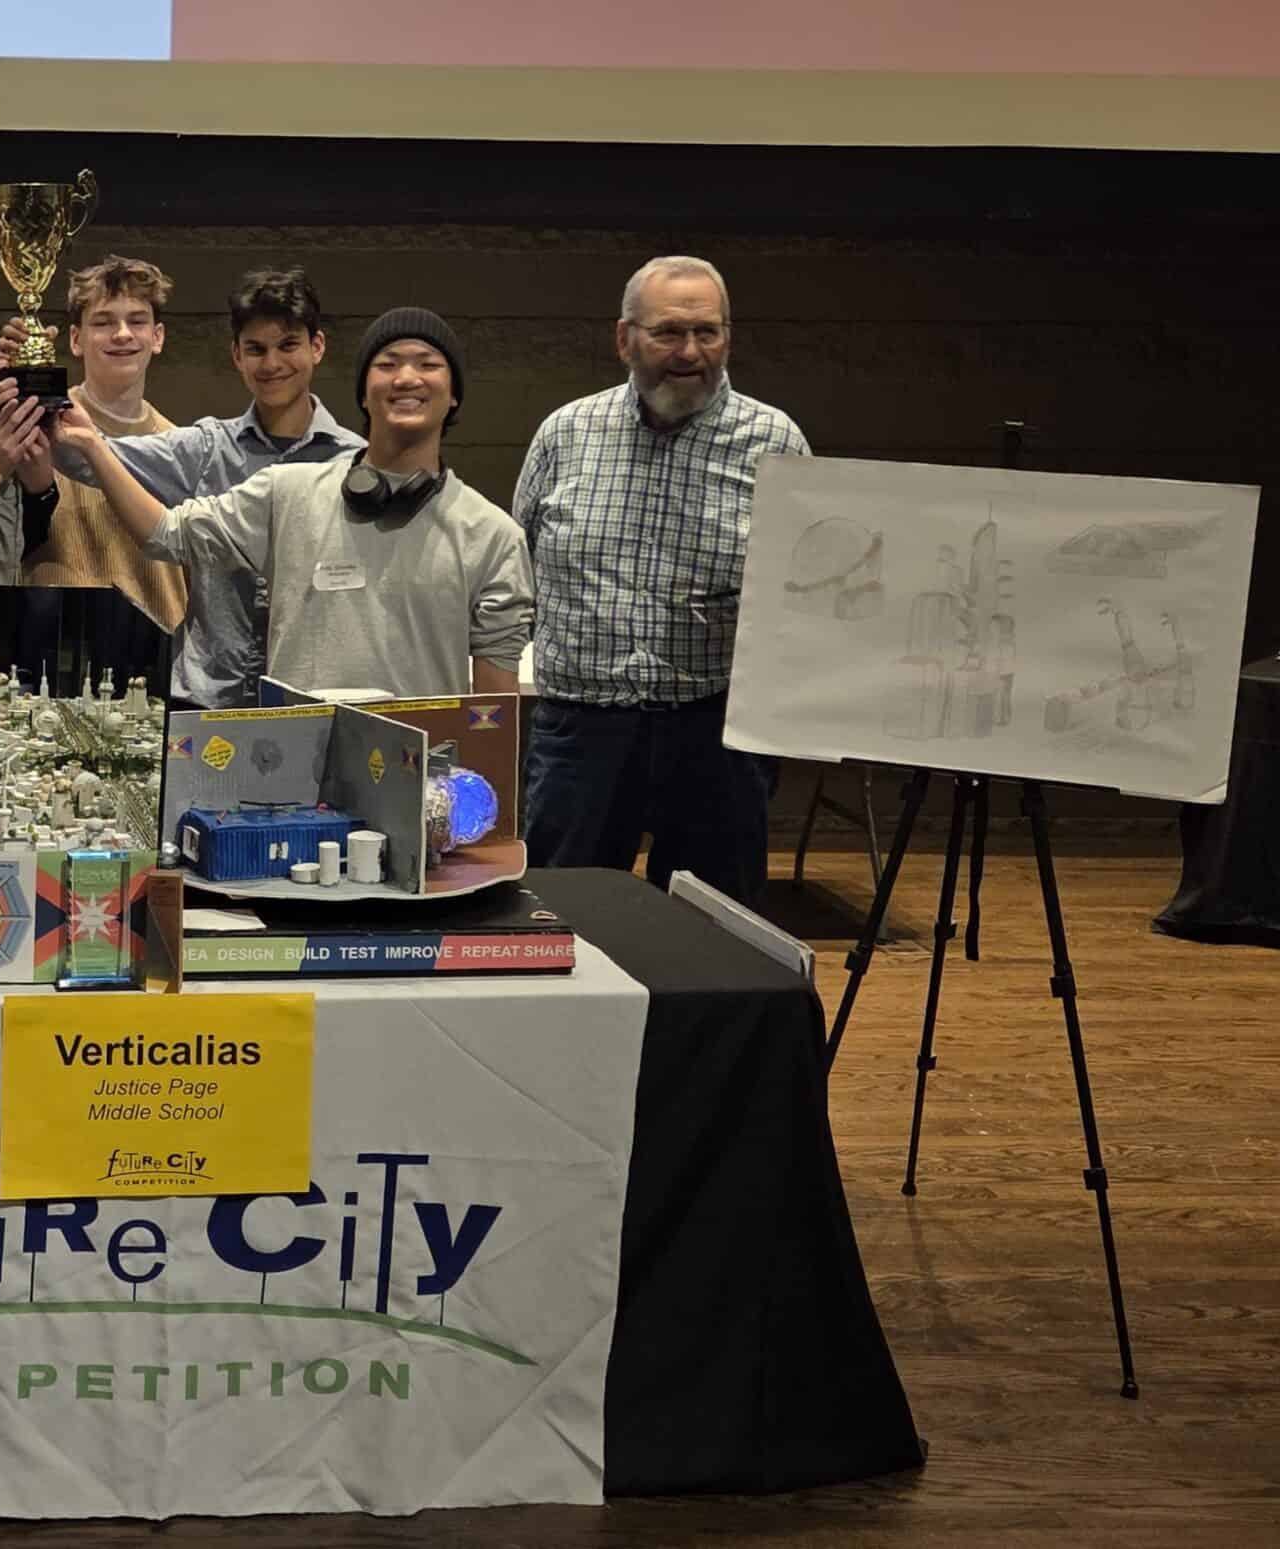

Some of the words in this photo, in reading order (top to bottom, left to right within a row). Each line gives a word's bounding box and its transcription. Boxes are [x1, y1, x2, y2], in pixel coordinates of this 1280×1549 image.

[218, 947, 274, 961] DESIGN
[285, 947, 330, 961] BUILD
[340, 946, 377, 960] TEST
[385, 945, 454, 960] IMPROVE
[461, 945, 521, 959] REPEAT
[523, 944, 575, 958] SHARE
[54, 1034, 261, 1067] Verticalias
[94, 1078, 162, 1096] Justice
[168, 1078, 218, 1099] Page
[88, 1103, 152, 1121] Middle
[158, 1103, 224, 1121] School
[114, 1178, 196, 1186] COMPETITION
